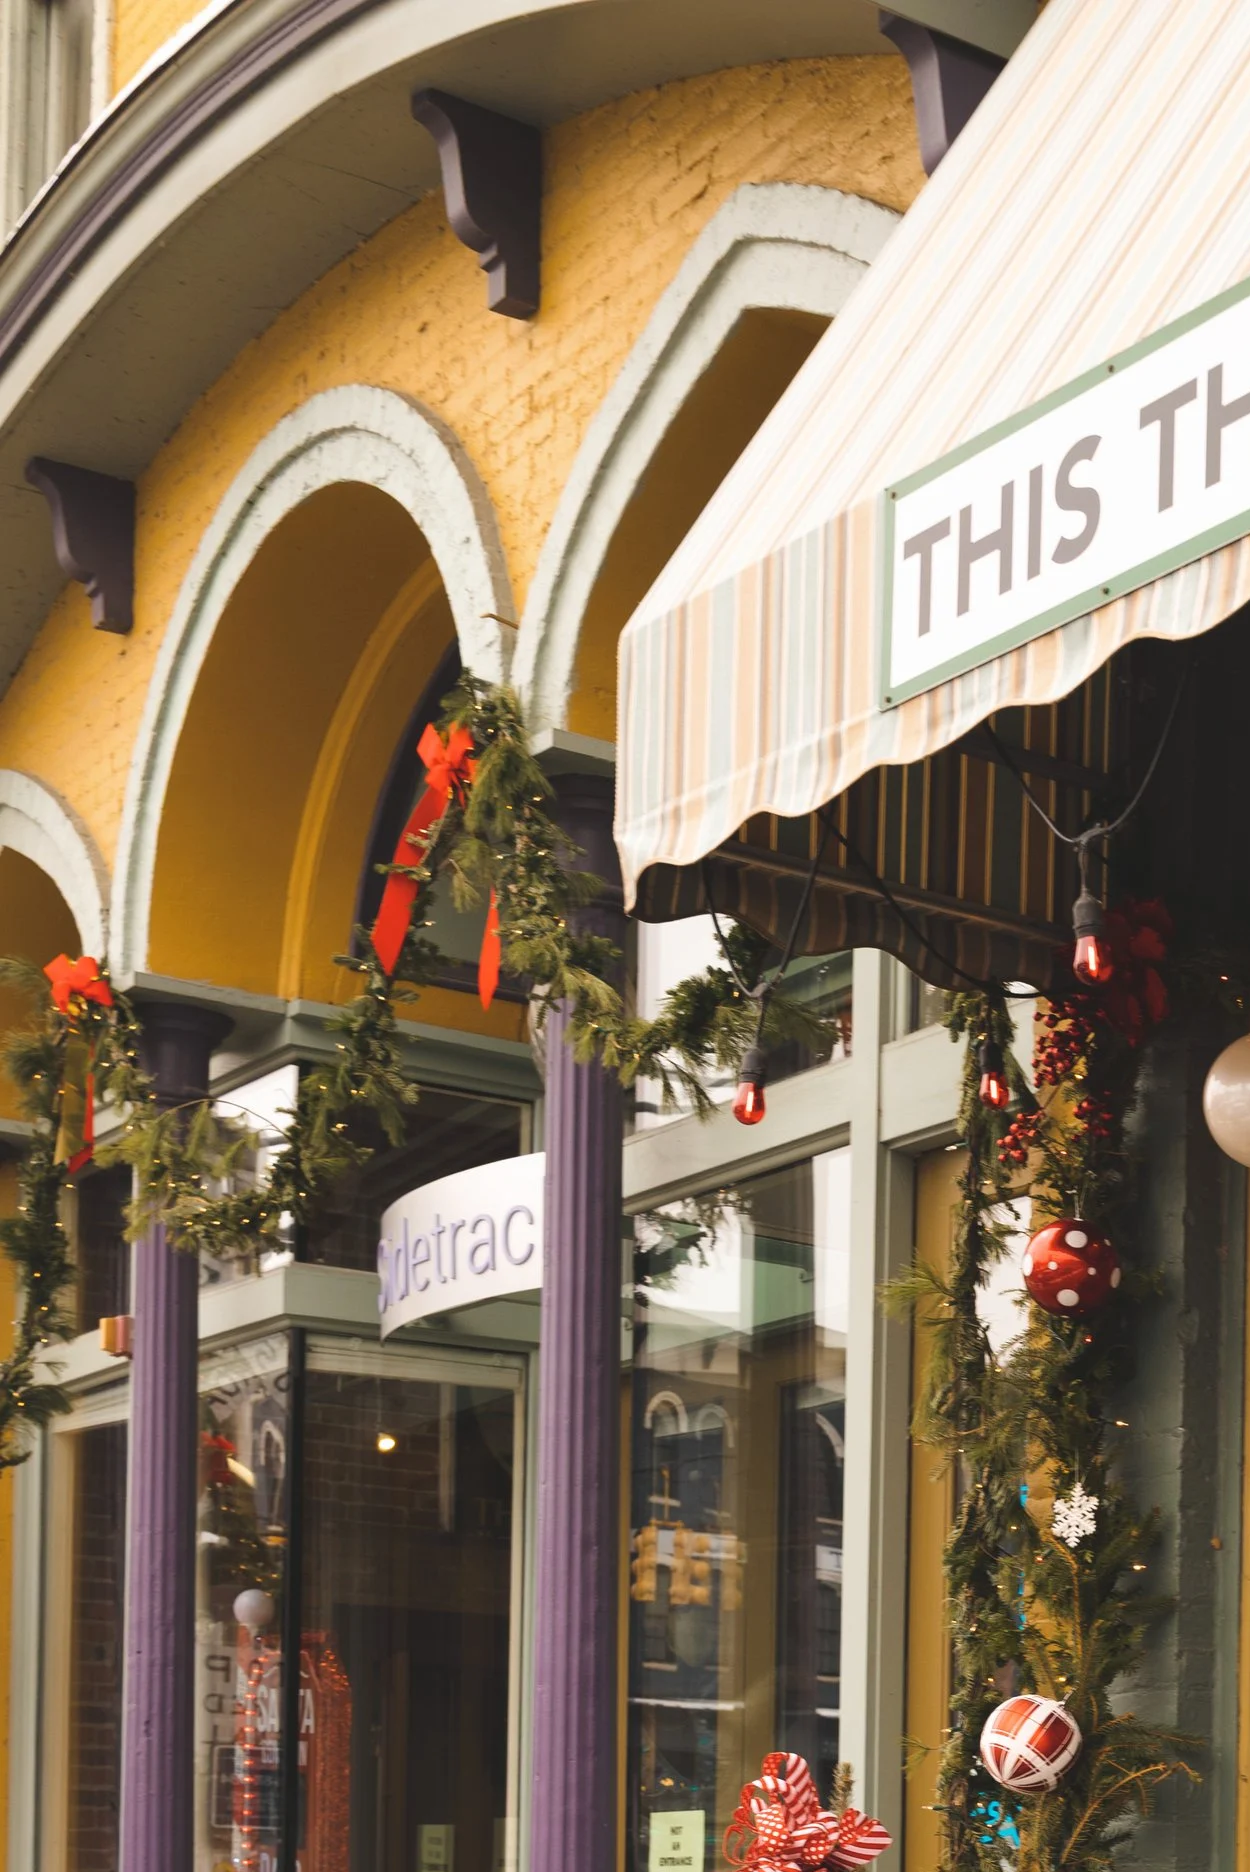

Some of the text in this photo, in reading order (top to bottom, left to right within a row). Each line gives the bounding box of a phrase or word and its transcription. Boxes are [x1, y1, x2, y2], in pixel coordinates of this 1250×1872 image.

[903, 434, 1102, 638] THIS
[669, 1826, 683, 1836] NOT
[672, 1842, 680, 1851] AN
[659, 1856, 693, 1867] ENTRANCE
